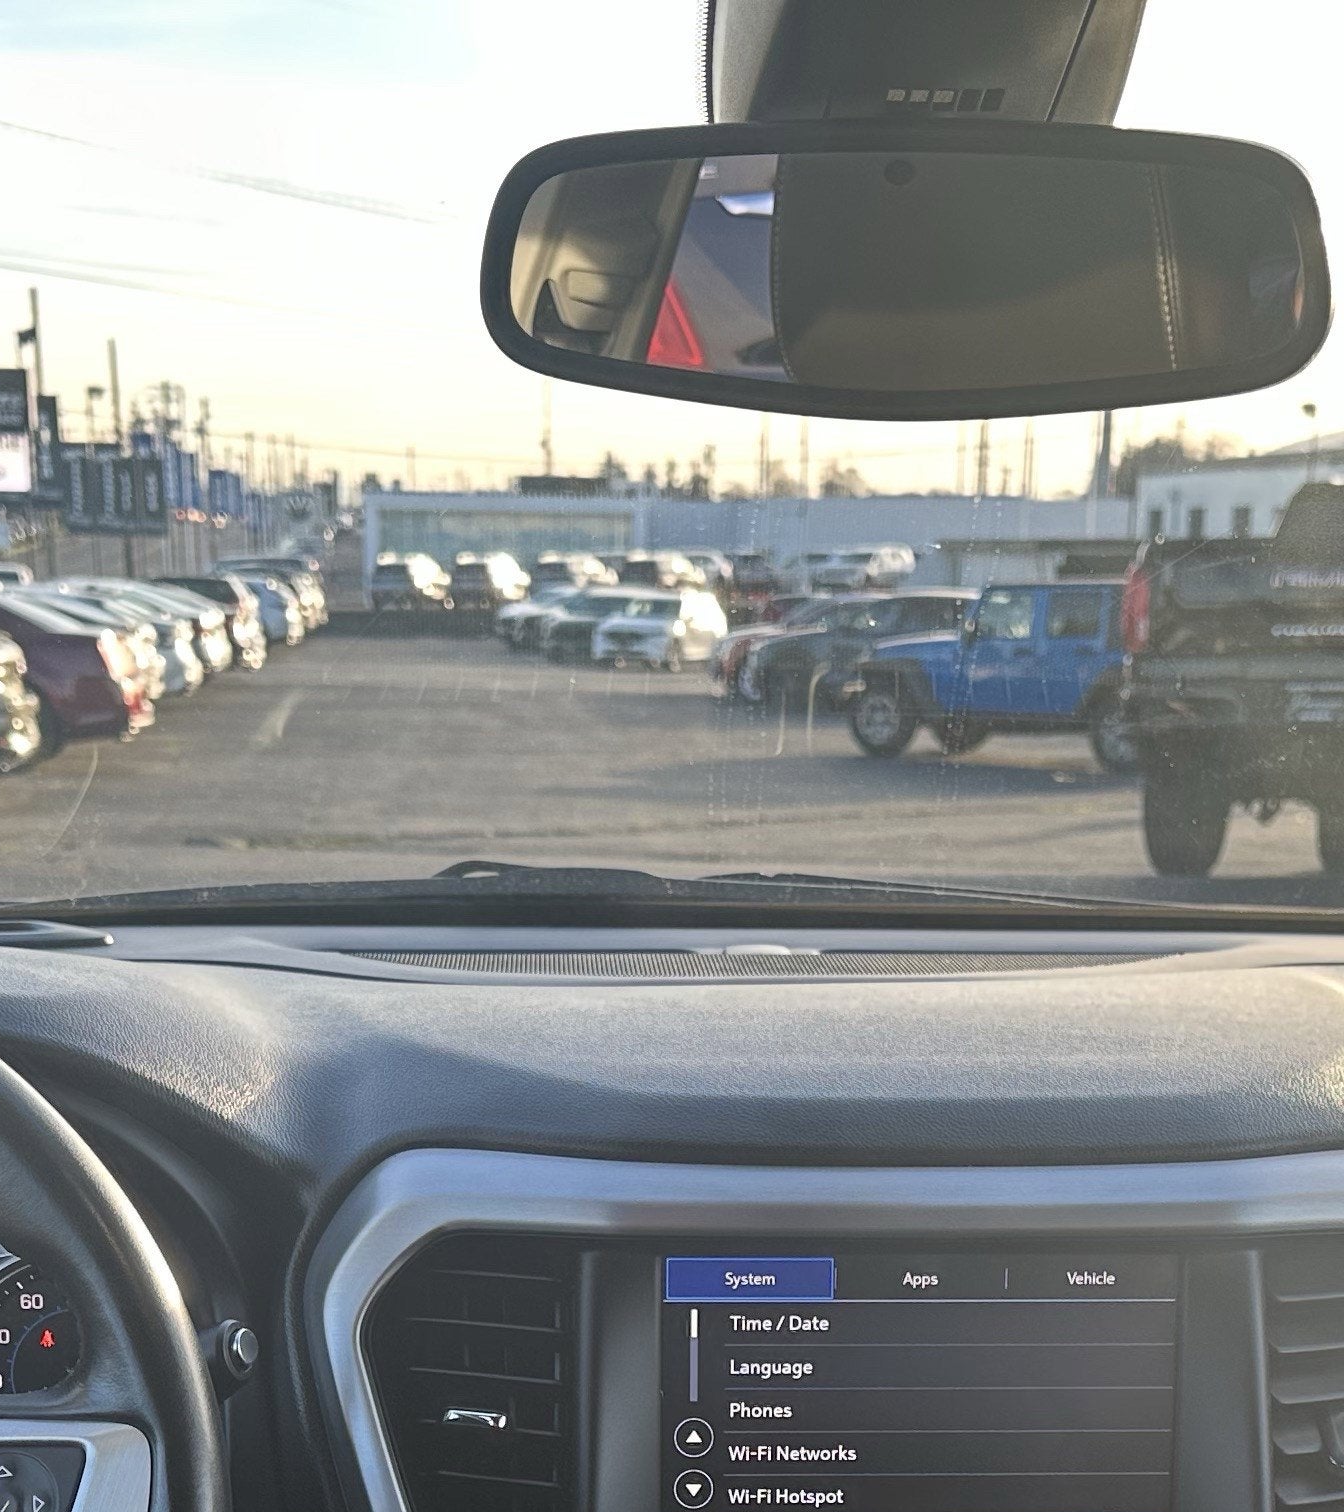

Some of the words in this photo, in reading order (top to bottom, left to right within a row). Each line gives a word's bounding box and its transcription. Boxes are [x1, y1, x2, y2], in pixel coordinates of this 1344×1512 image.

[724, 1271, 776, 1288] System
[902, 1271, 939, 1288] Apps
[1066, 1271, 1116, 1286] Vehicle
[19, 1293, 44, 1310] 60
[729, 1315, 772, 1331] Time
[789, 1315, 830, 1331] Date
[729, 1359, 814, 1379] Language
[729, 1403, 793, 1418] Phones
[728, 1446, 772, 1461] Wi-Fi
[776, 1446, 857, 1461] Networks
[728, 1488, 772, 1504] Wi-Fi
[776, 1488, 844, 1508] Hotspot
